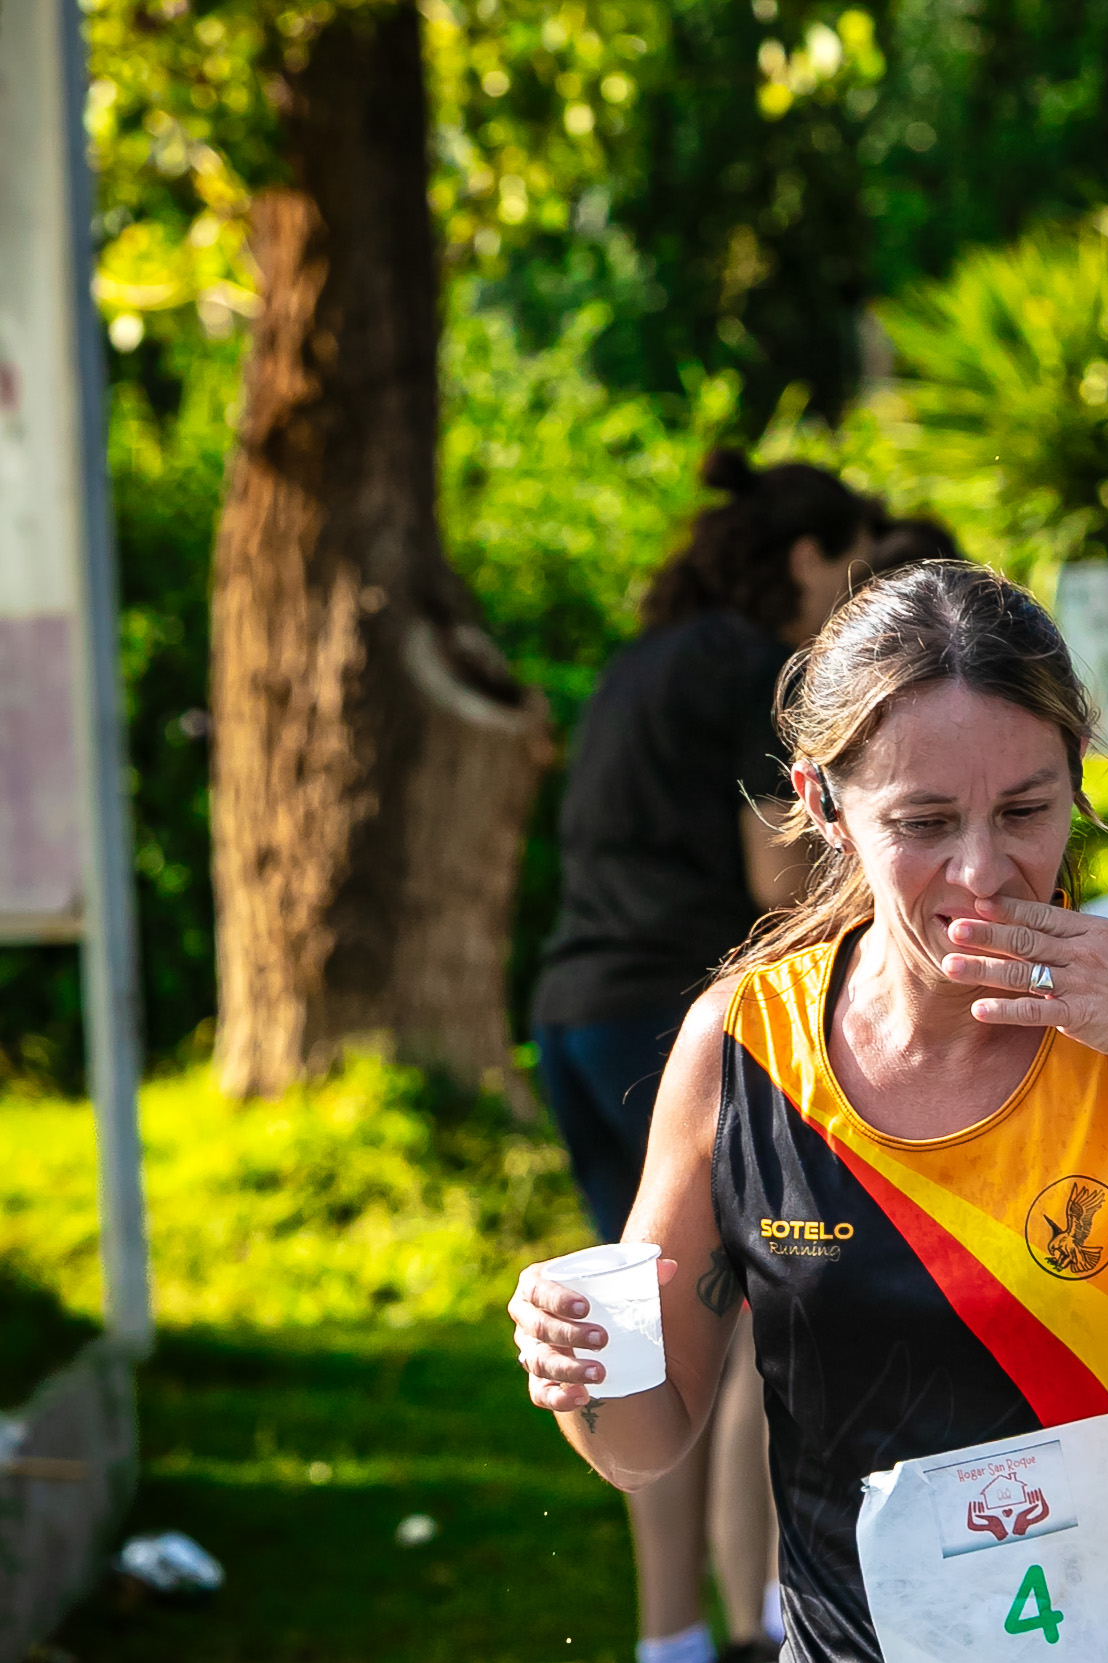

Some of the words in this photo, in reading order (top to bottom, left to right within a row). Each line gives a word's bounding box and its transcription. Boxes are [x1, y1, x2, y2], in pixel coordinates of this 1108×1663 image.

[760, 1218, 854, 1240] SOTELO
[769, 1241, 841, 1262] Running
[957, 1467, 986, 1483] Hogar
[987, 1462, 1006, 1477] San
[1005, 1456, 1037, 1471] Roque
[1004, 1563, 1064, 1645] 4
